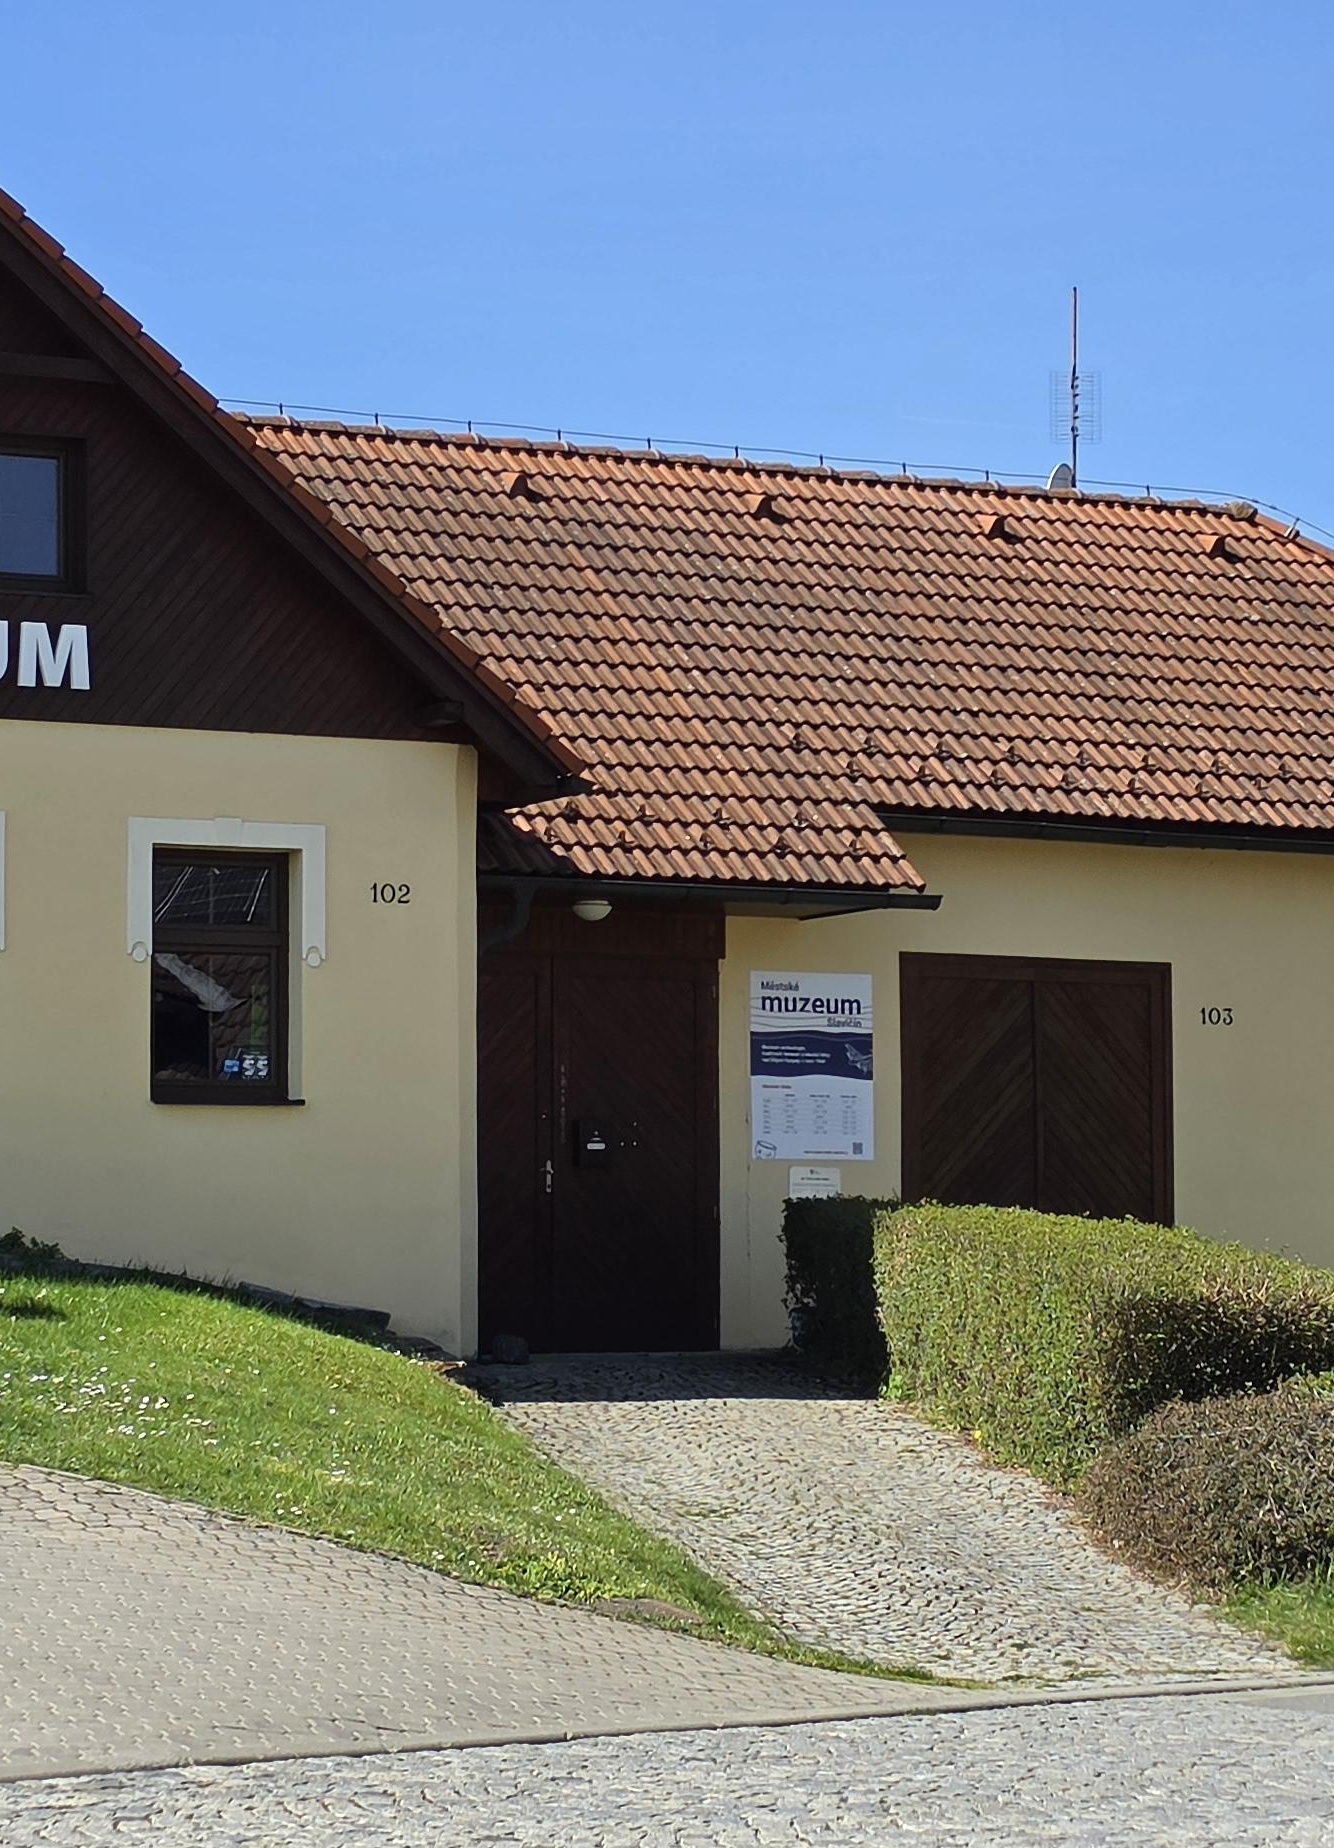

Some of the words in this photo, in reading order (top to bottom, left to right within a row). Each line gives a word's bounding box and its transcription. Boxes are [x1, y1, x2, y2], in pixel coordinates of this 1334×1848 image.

[370, 882, 411, 904] 102
[761, 996, 862, 1015] muzeum
[1199, 1007, 1234, 1026] 103
